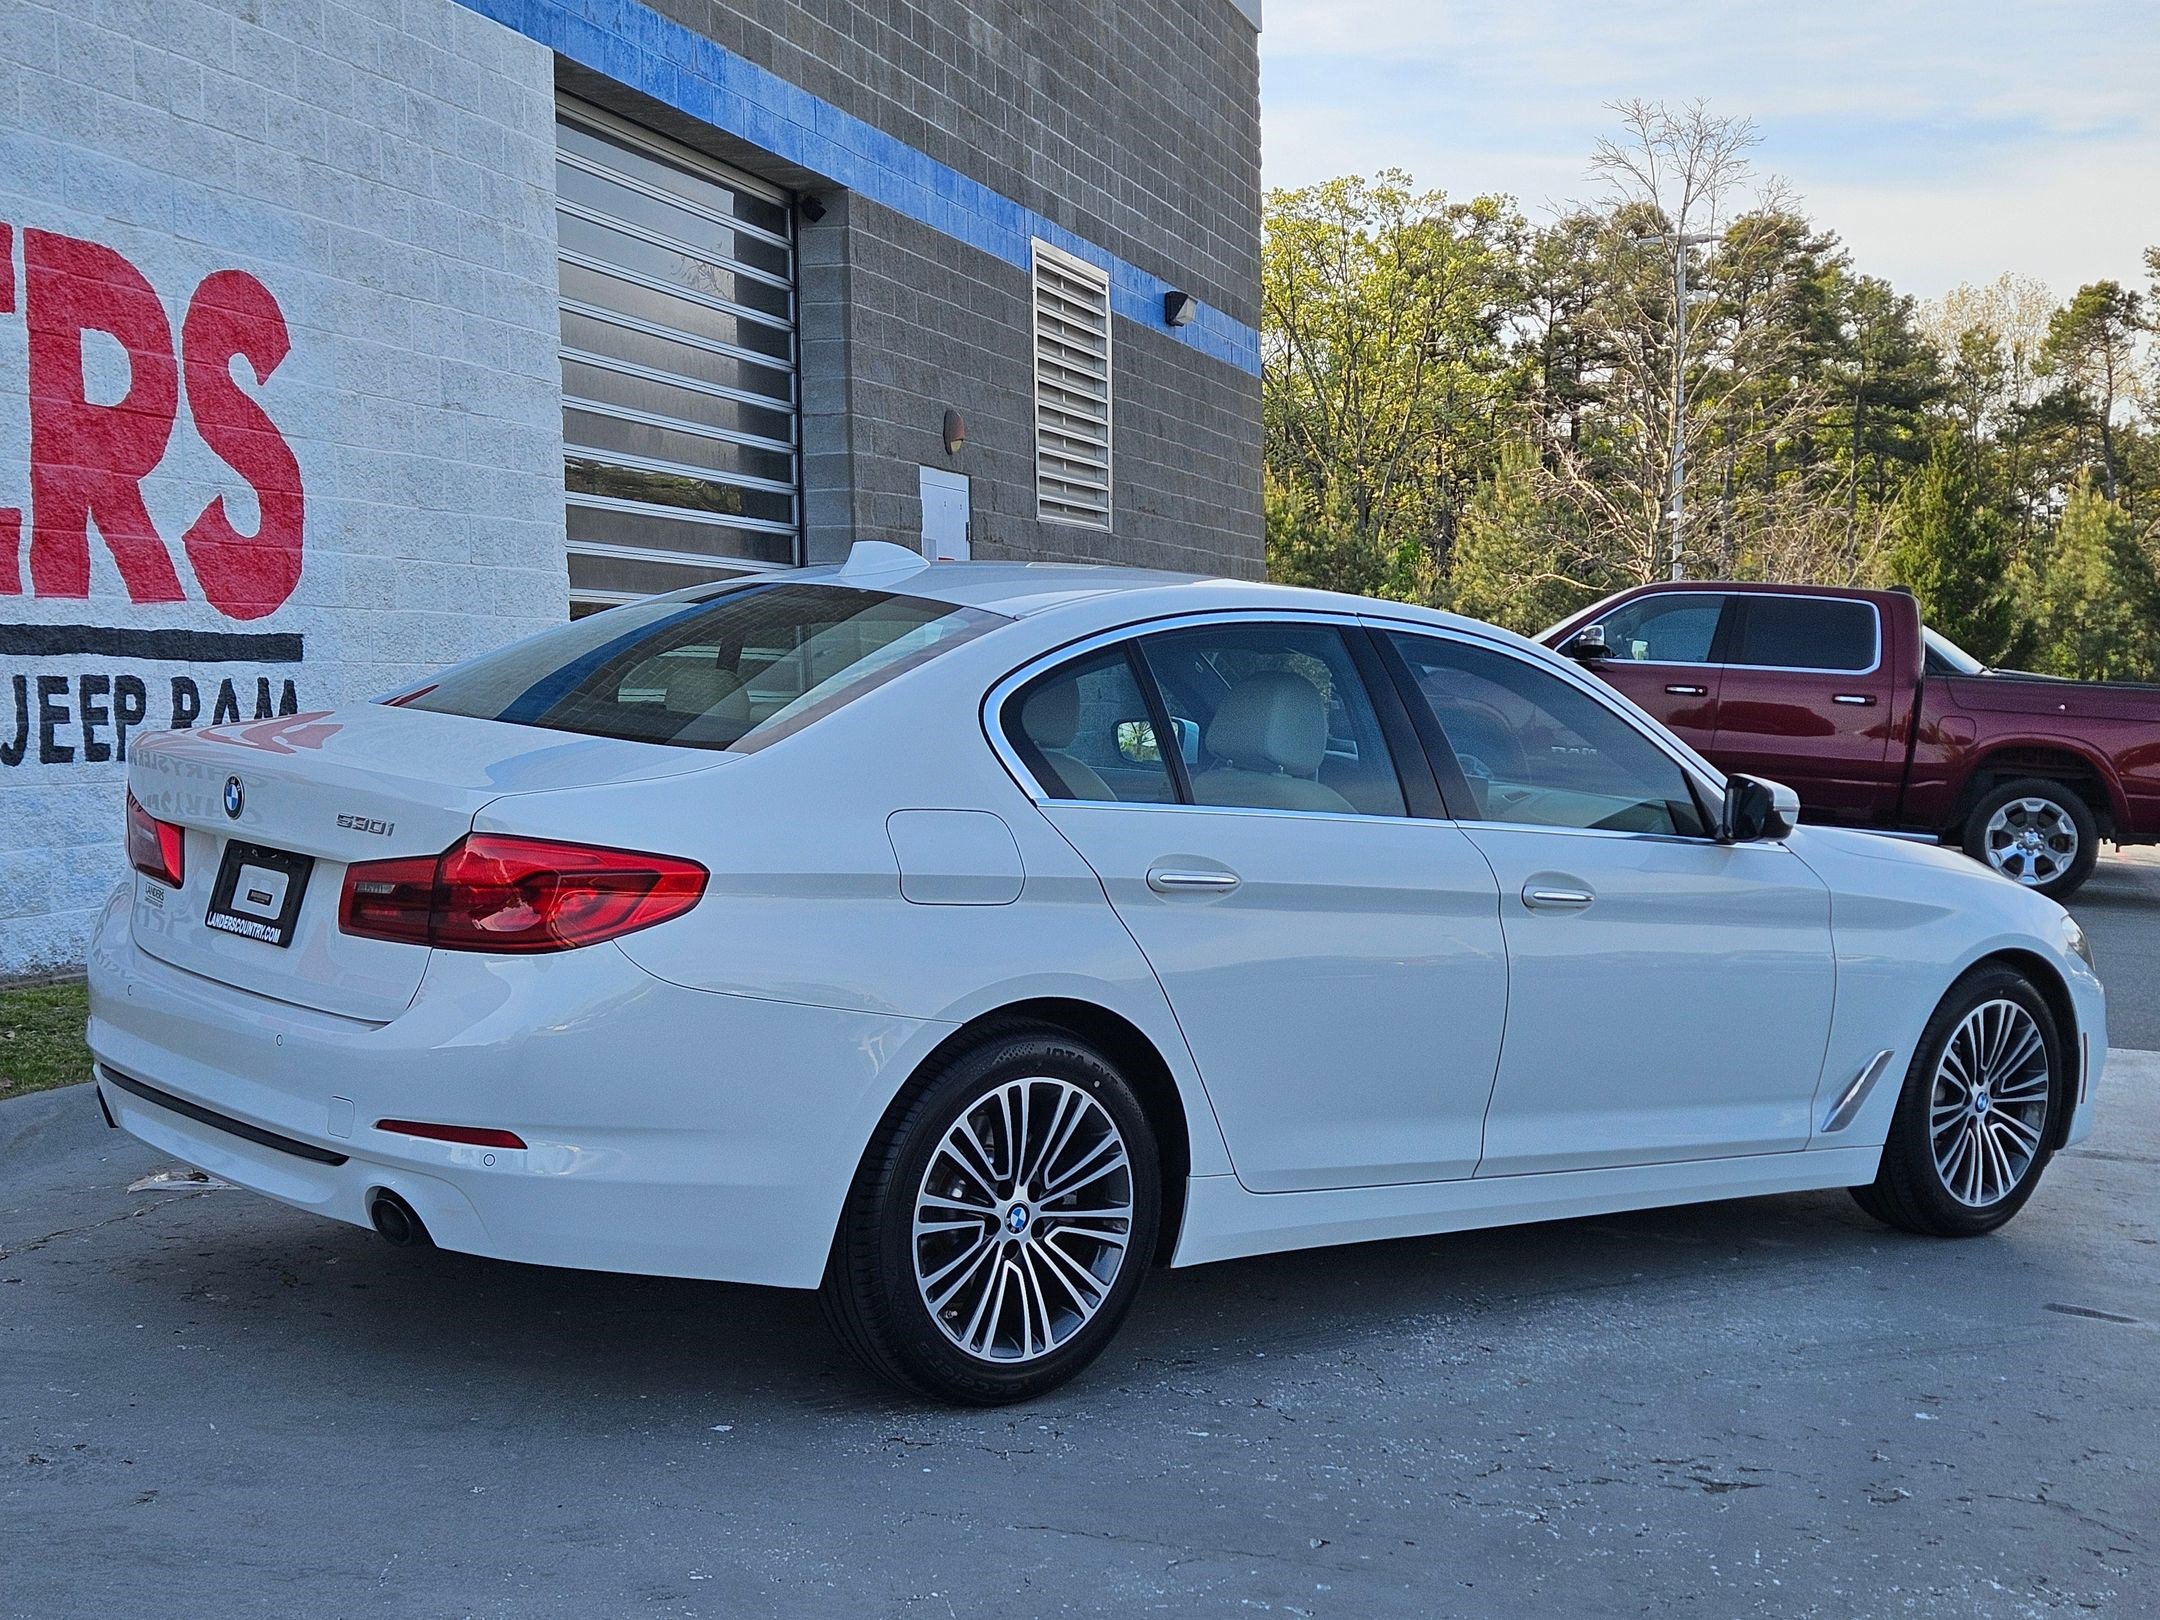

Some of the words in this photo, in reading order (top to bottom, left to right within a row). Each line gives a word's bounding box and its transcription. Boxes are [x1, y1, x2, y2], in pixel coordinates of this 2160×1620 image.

[0, 221, 305, 621] RS
[0, 674, 146, 766] JEEP
[336, 813, 395, 837] 530i
[206, 911, 281, 943] LANDERSCOUNTRY.COM
